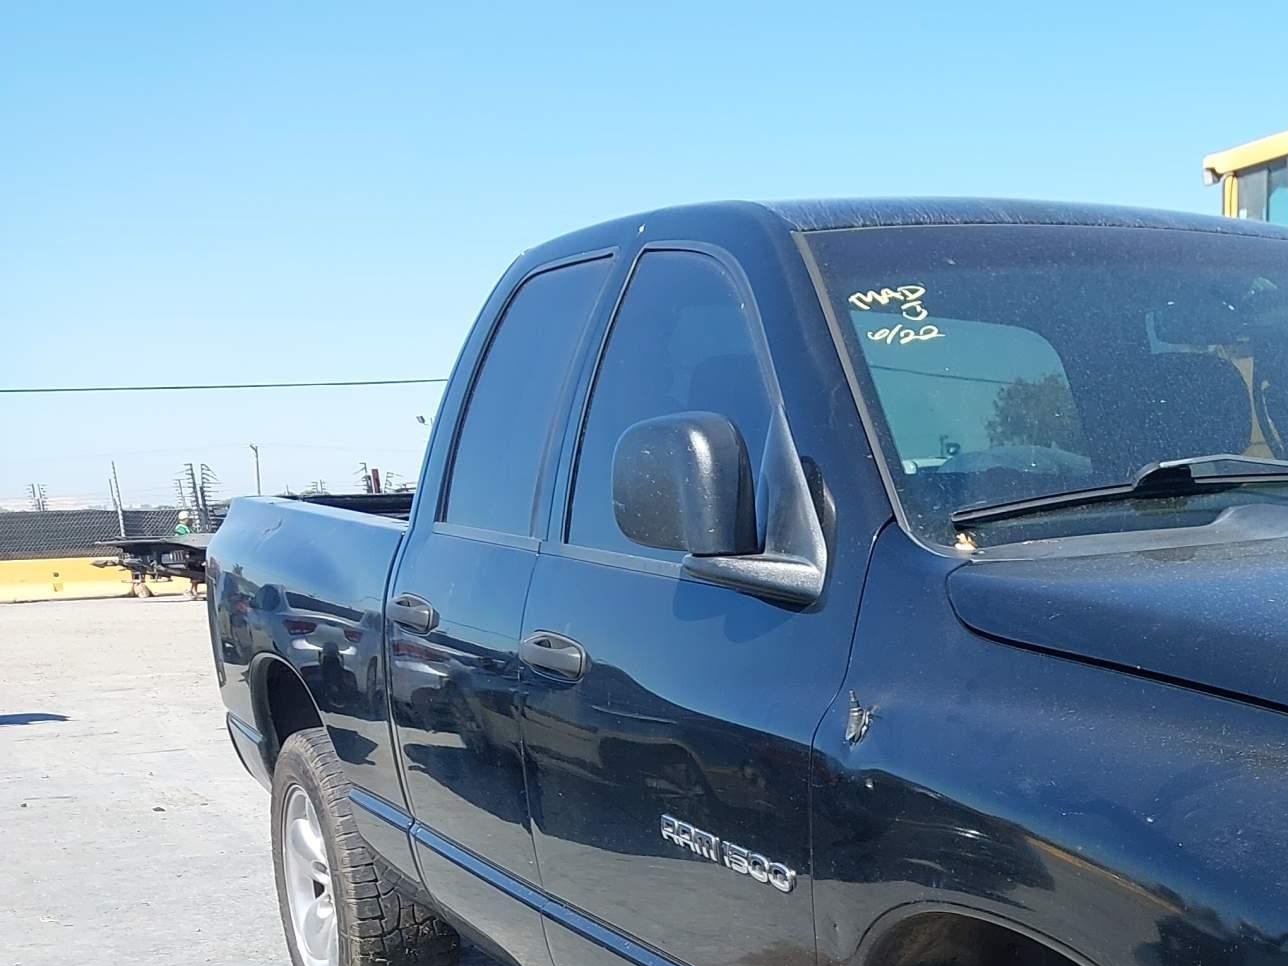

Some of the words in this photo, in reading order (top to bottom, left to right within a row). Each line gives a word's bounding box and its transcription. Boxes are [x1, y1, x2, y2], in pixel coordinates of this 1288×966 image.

[848, 284, 927, 310] MAD
[660, 813, 722, 863] RAM
[721, 839, 798, 893] 1500
